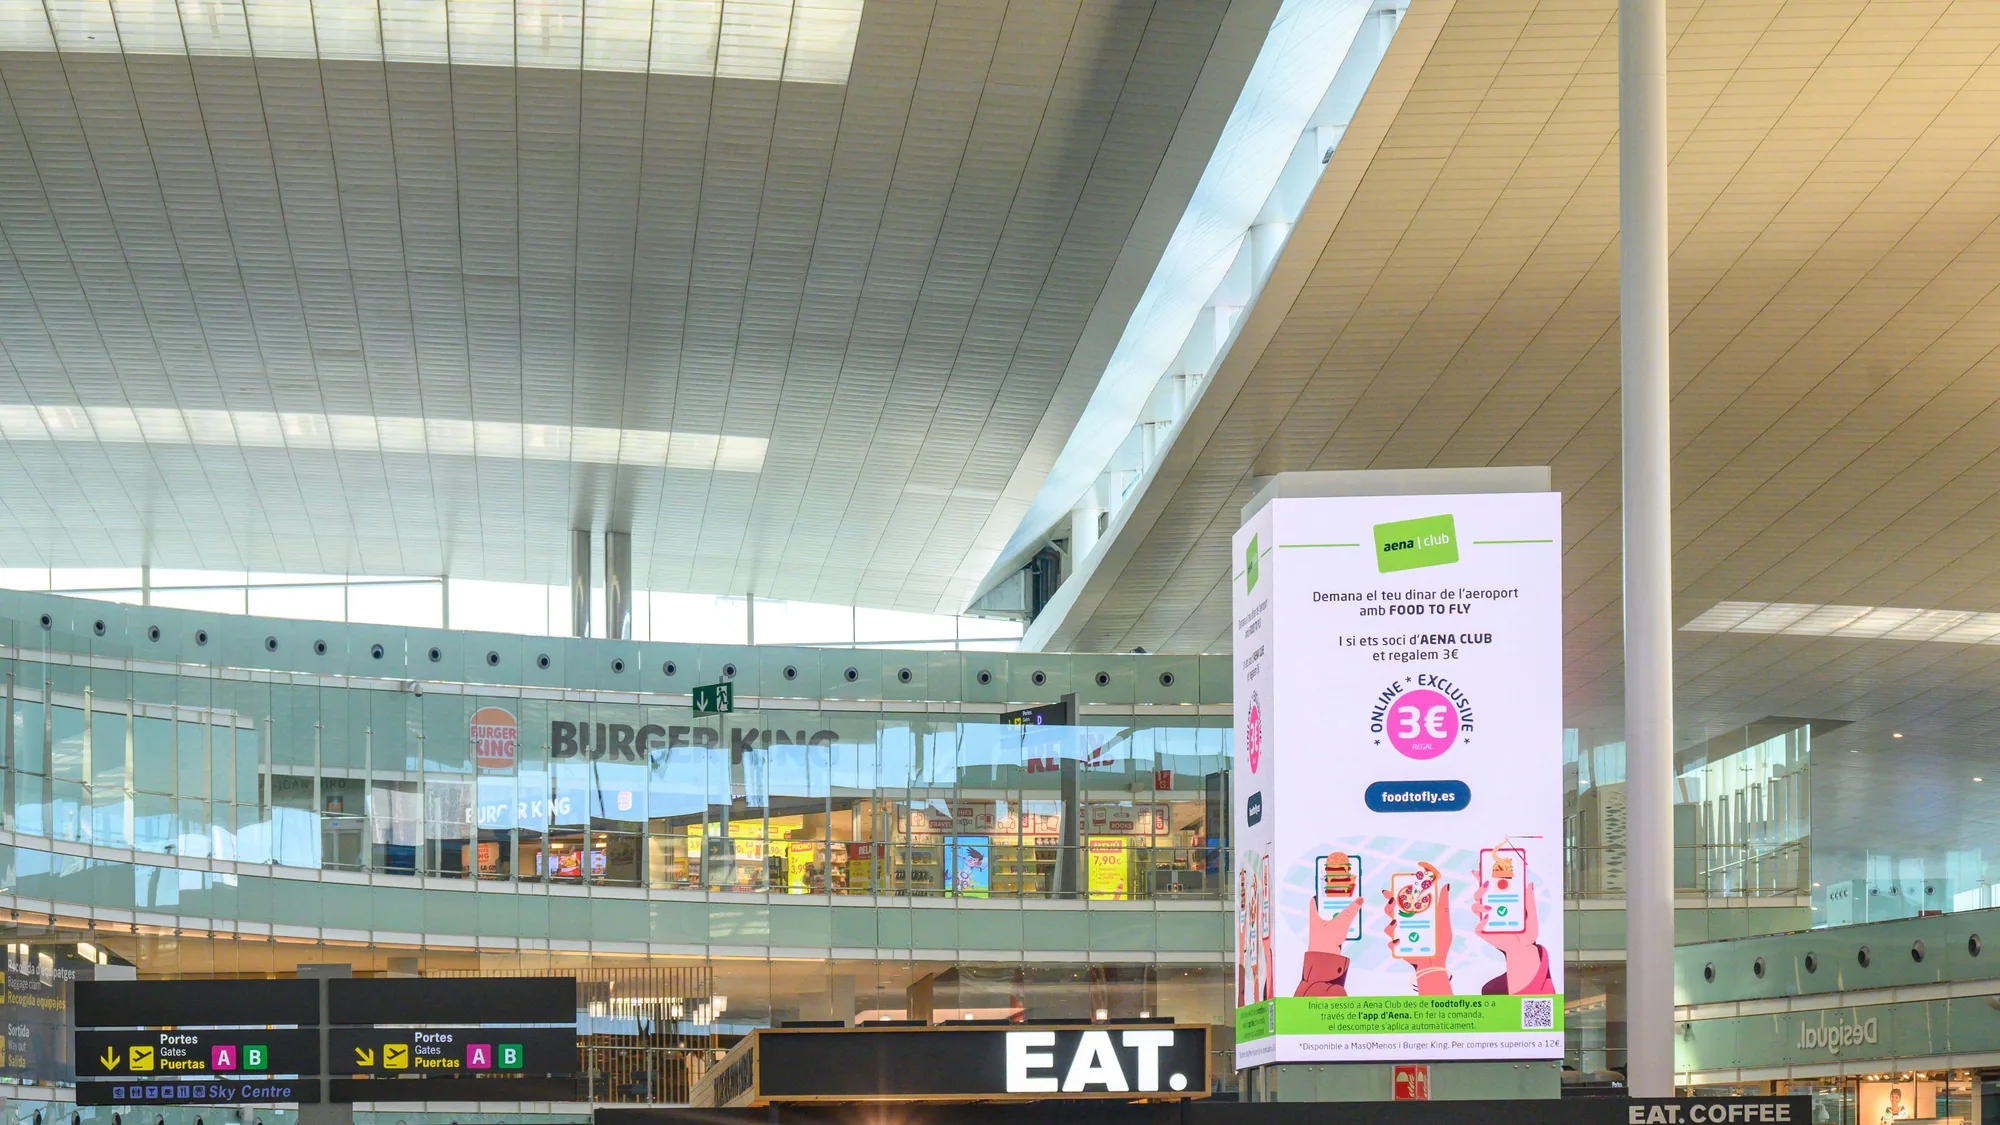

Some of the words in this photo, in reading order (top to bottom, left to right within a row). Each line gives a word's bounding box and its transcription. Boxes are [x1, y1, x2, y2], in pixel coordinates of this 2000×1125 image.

[1384, 539, 1414, 552] aena
[1424, 533, 1450, 548] club
[1312, 591, 1363, 602] Demana
[1366, 589, 1377, 601] el
[1381, 590, 1401, 601] teu
[1405, 589, 1436, 600] dinar
[1440, 588, 1455, 600] de
[1458, 588, 1519, 601] l'aeroport
[1359, 604, 1386, 616] amb
[1389, 604, 1425, 616] FOOD
[1429, 603, 1445, 615] TO
[1449, 603, 1471, 614] FLY
[1339, 636, 1343, 647] I
[1346, 635, 1356, 647] si
[1359, 636, 1379, 647] ets
[1382, 634, 1406, 646] soci
[1409, 633, 1456, 646] d'AENA
[1460, 633, 1493, 645] CLUB
[1372, 651, 1386, 661] et
[1389, 649, 1438, 663] regalem
[1443, 648, 1459, 660] 3€
[1370, 680, 1403, 733] ONLINE
[1418, 674, 1474, 733] EXCLUSIVE
[1398, 705, 1448, 739] 3€
[471, 726, 517, 740] BURGER
[471, 739, 515, 757] KING
[551, 720, 719, 763] BURGER
[731, 727, 840, 767] KING
[1381, 789, 1455, 803] foodtofly.es
[7, 975, 29, 990] Baggage
[7, 991, 36, 1007] Recogida
[36, 996, 66, 1012] equipajes
[1308, 1001, 1329, 1010] Inicia
[1330, 1000, 1354, 1010] sessió
[1363, 1000, 1383, 1009] Aena
[1384, 1000, 1402, 1009] Club
[1403, 1000, 1417, 1009] des
[1418, 1000, 1429, 1009] de
[1431, 999, 1482, 1010] foodtofly.es
[1320, 1012, 1345, 1021] través
[1346, 1012, 1357, 1020] de
[1358, 1011, 1378, 1021] l'app
[1381, 1010, 1412, 1020] d'Aena.
[1413, 1010, 1424, 1019] En
[1425, 1010, 1437, 1019] fer
[1438, 1010, 1446, 1019] la
[7, 1023, 30, 1038] Sortida
[1328, 1022, 1336, 1031] el
[1337, 1022, 1380, 1032] descompte
[1381, 1021, 1409, 1031] s'aplica
[160, 1033, 198, 1045] Portes
[414, 1032, 453, 1043] Portes
[7, 1039, 20, 1052] Way
[160, 1047, 187, 1057] Gates
[414, 1045, 441, 1055] Gates
[1351, 1042, 1396, 1050] MasQMenos
[1403, 1041, 1428, 1051] Burger
[1430, 1041, 1450, 1050] King.
[1451, 1040, 1464, 1049] Per
[1466, 1041, 1498, 1050] compres
[1500, 1040, 1536, 1049] superiors
[8, 1054, 26, 1068] Salida
[217, 1049, 231, 1066] A
[249, 1049, 262, 1066] B
[414, 1057, 460, 1068] Puertas
[471, 1048, 486, 1065] A
[504, 1048, 517, 1065] B
[1005, 1029, 1189, 1094] EAT.
[160, 1058, 205, 1070] Puertas
[208, 1085, 236, 1101] Sky
[241, 1084, 291, 1098] Centre
[1628, 1103, 1685, 1125] EAT.
[1689, 1103, 1791, 1123] COFFEE
